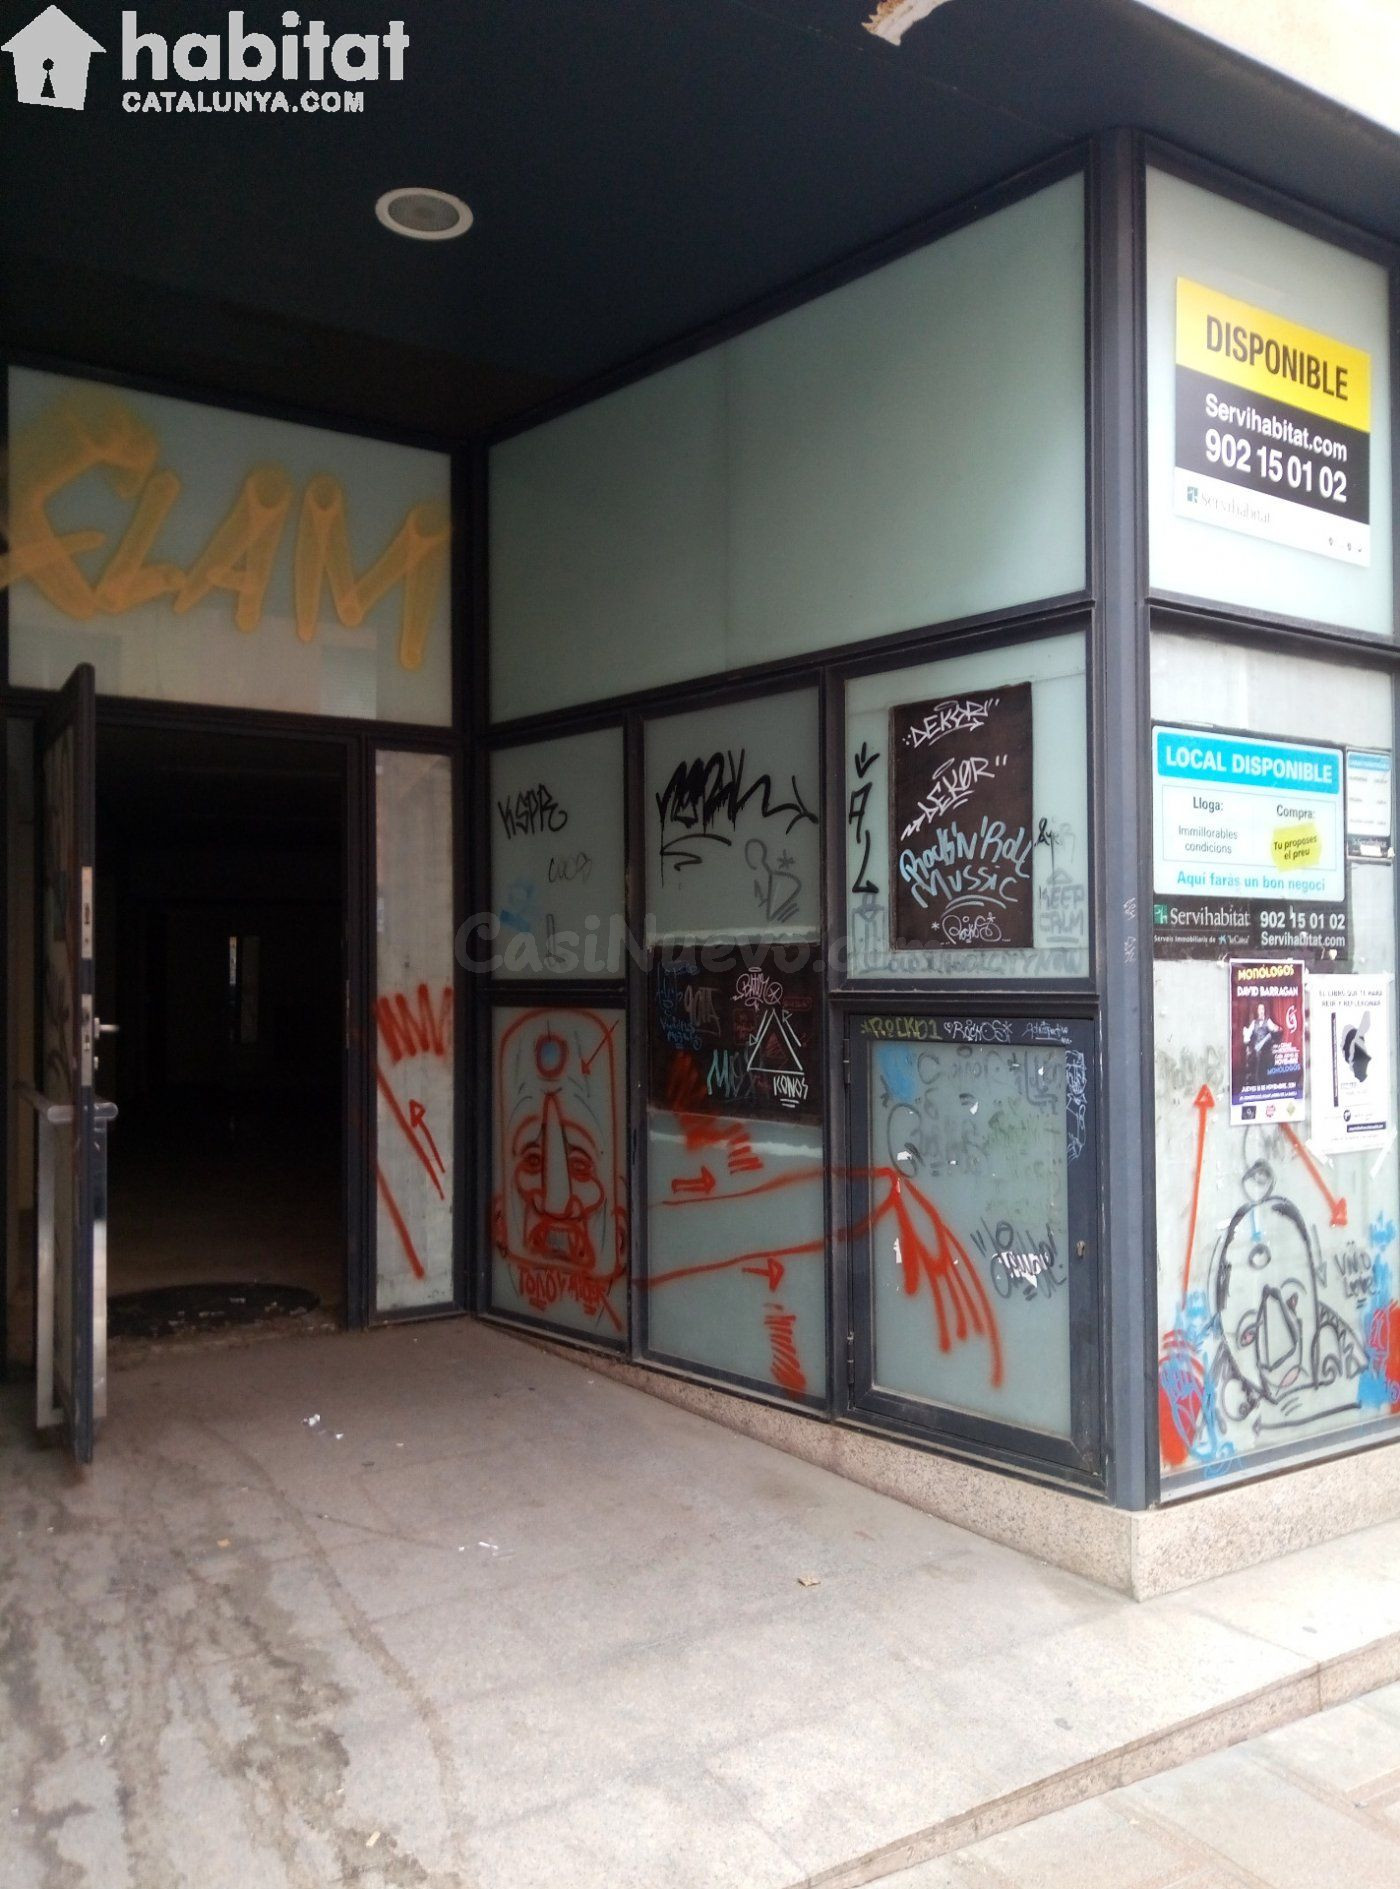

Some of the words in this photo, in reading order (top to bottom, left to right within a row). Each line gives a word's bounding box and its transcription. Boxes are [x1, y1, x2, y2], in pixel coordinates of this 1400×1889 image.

[1206, 313, 1349, 401] DISPONIBLE
[1205, 392, 1348, 462] Servihabitat.com
[1205, 428, 1252, 474] 902
[1256, 445, 1283, 483] 15
[1287, 455, 1313, 493] 01
[1319, 466, 1348, 503] 02
[1165, 745, 1227, 772] LOCAL
[1231, 753, 1334, 784] DISPONIBLE
[1192, 795, 1224, 813] Lloga:
[1178, 824, 1239, 841] Immillorables
[1184, 841, 1233, 855] condicions
[1273, 840, 1284, 851] Tu
[1284, 834, 1318, 852] proposes
[1284, 850, 1292, 860] el
[1292, 847, 1311, 861] preu
[1244, 877, 1259, 888] un
[1263, 874, 1285, 890] bon
[1288, 878, 1326, 894] negoci
[1169, 905, 1250, 928] Servihabitat
[1260, 911, 1286, 928] 902
[1291, 911, 1306, 929] 15
[1310, 913, 1325, 930] 01
[1330, 914, 1346, 930] 02
[1260, 930, 1346, 947] Servihabitat.com
[1237, 986, 1259, 997] DAVID
